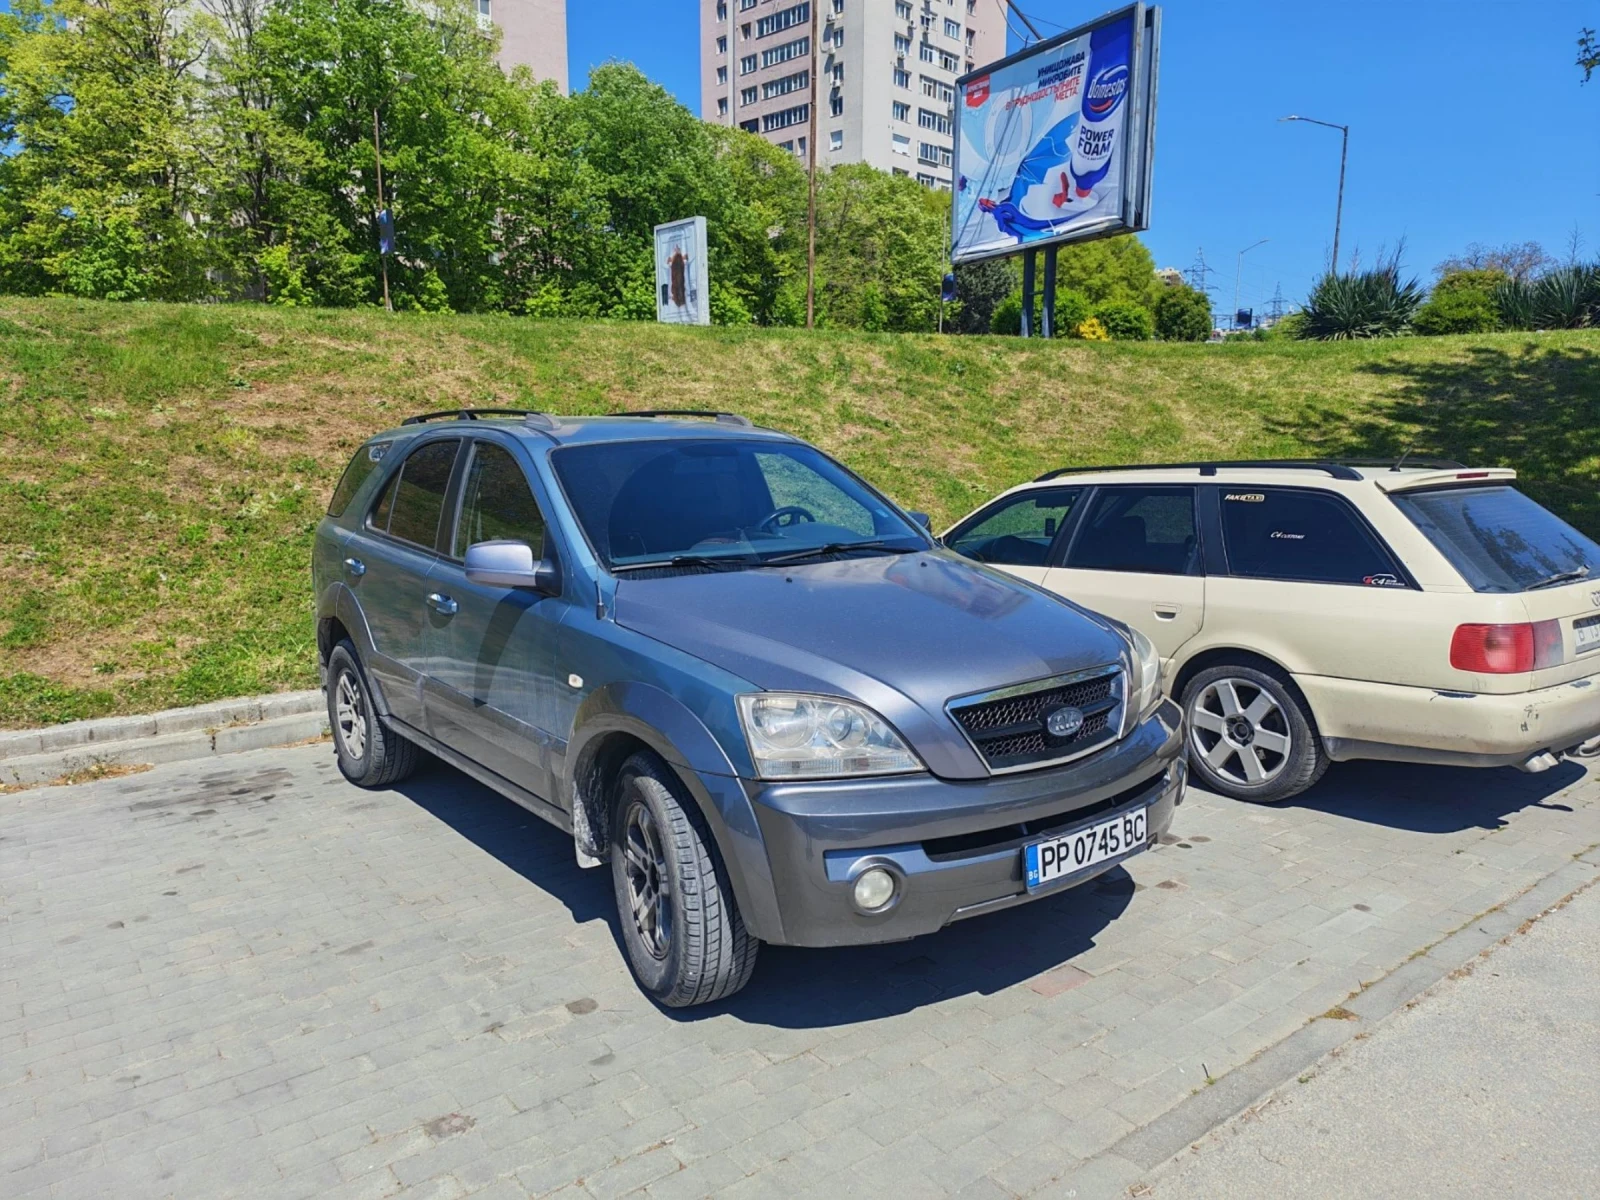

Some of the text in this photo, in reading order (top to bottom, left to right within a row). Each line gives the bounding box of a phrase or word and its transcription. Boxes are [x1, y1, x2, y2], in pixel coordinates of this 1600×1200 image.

[1037, 51, 1085, 78] УНИЩОЖАВА
[1037, 63, 1084, 89] МИКРОБИТЕ
[1080, 124, 1115, 142] POWER
[1077, 137, 1111, 156] FOAM
[1041, 813, 1144, 877] PP 0745 BC
[1028, 869, 1038, 881] BG
